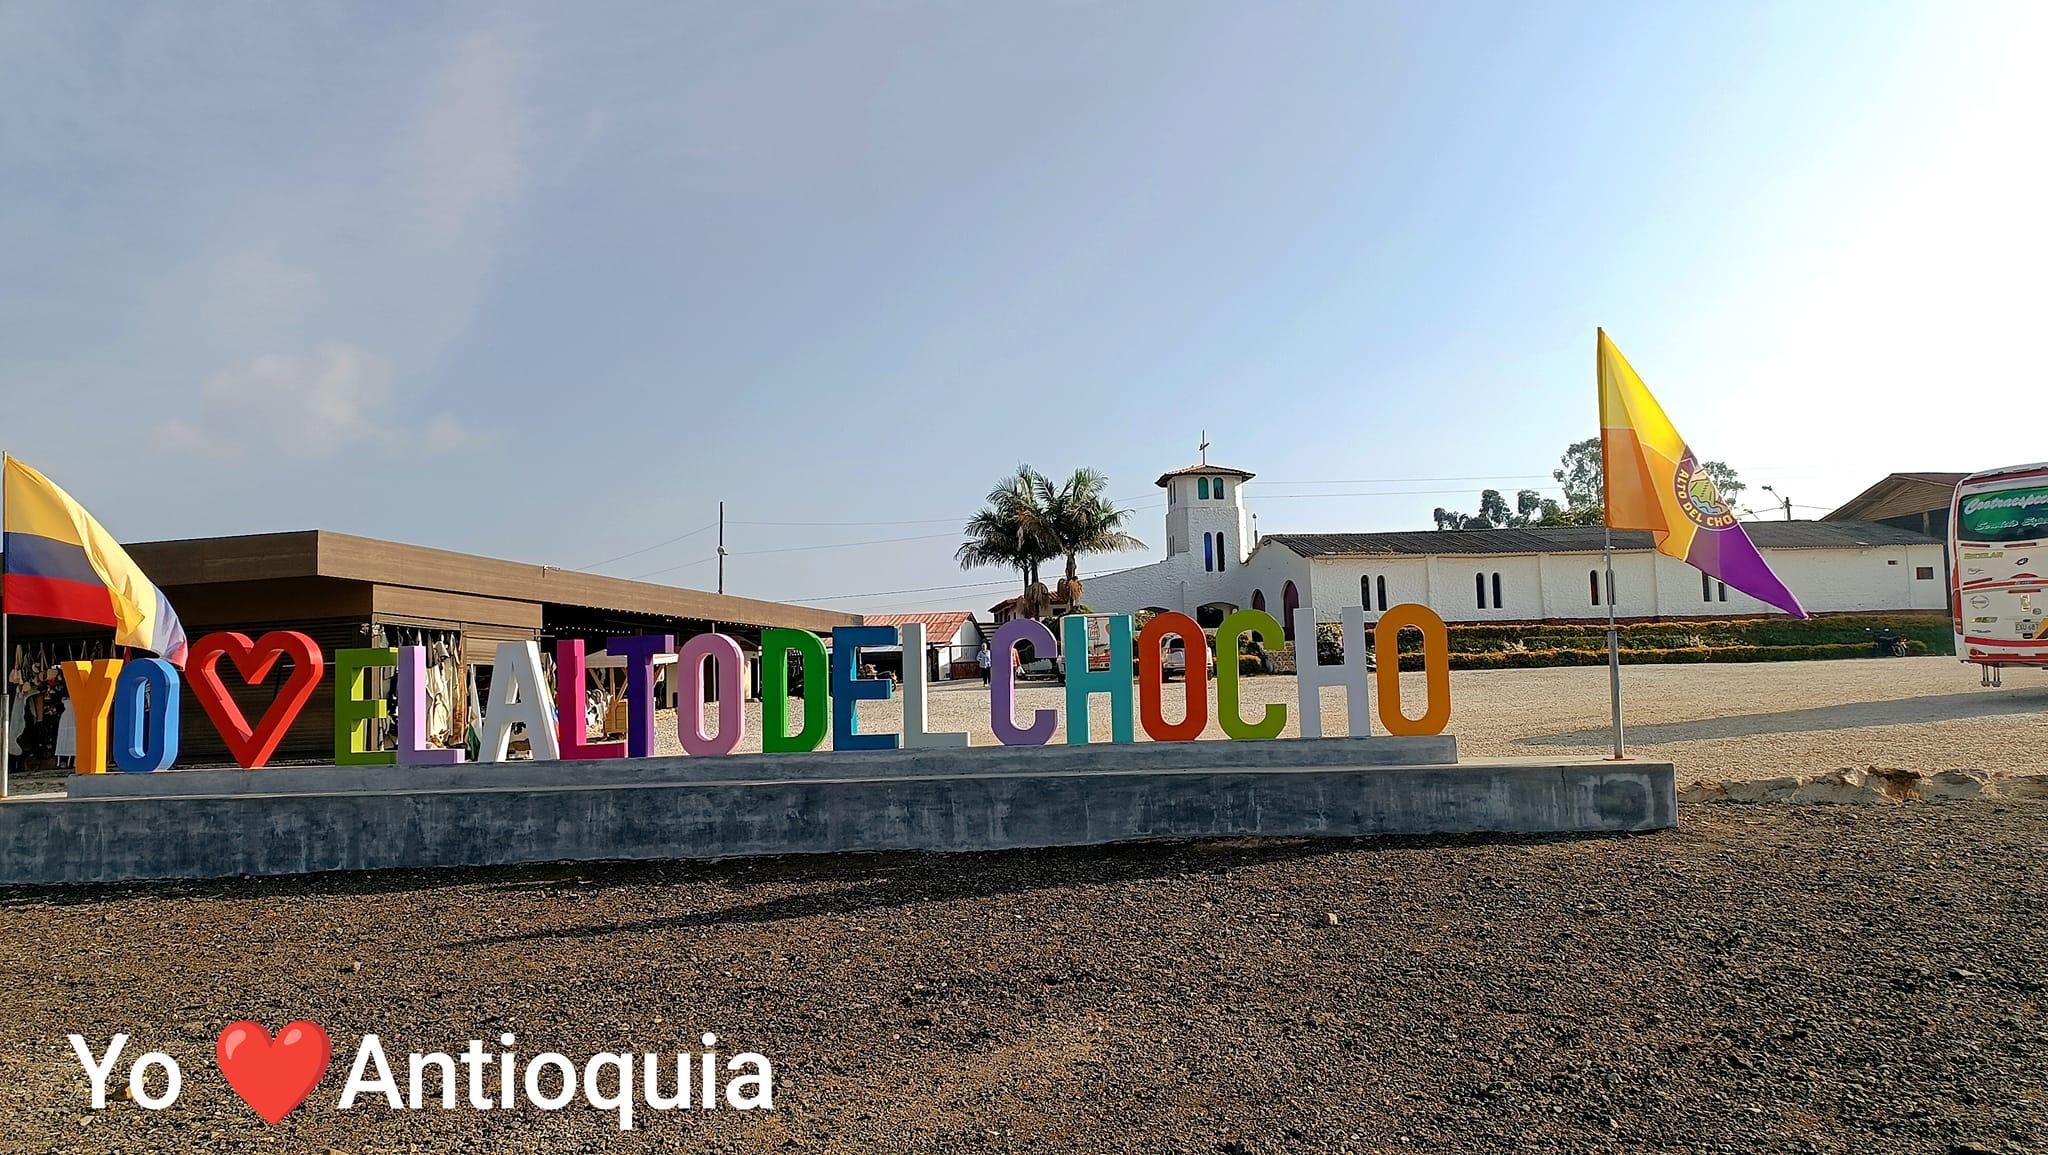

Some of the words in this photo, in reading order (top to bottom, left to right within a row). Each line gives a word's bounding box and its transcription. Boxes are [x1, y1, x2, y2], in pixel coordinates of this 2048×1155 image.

[1677, 469, 1689, 499] ALTO
[1682, 501, 1703, 523] DEL
[1706, 515, 1733, 527] CHO
[60, 657, 181, 774] YO
[335, 645, 465, 766] EL
[478, 632, 746, 762] ALTO
[762, 622, 971, 753] DEL
[990, 602, 1450, 747] CHOCHO
